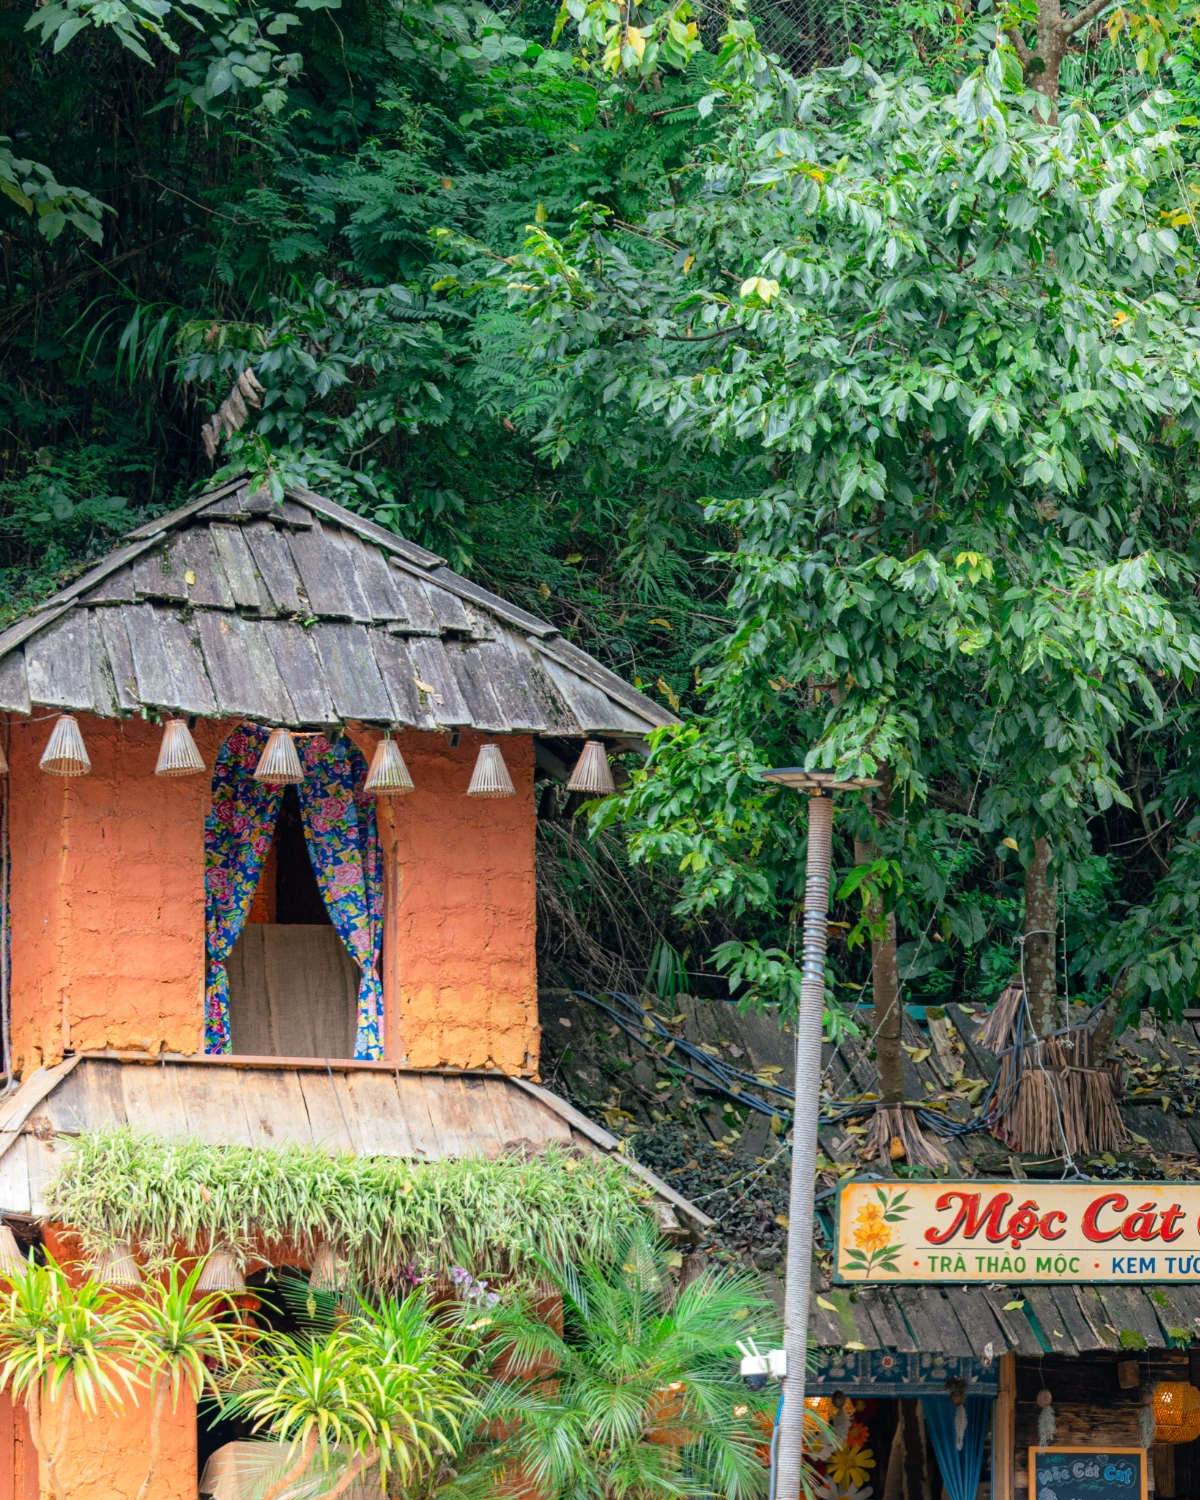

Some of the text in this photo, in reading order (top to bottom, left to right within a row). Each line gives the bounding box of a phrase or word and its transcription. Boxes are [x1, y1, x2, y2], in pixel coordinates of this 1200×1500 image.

[924, 1191, 1067, 1250] Mộc
[1081, 1192, 1185, 1243] Cát
[927, 1252, 967, 1273] TRÀ
[975, 1251, 1026, 1273] THẢO
[1036, 1253, 1080, 1277] MỘC
[1112, 1257, 1156, 1275] KEM
[1038, 1461, 1132, 1485] Mộc Cát Cát
